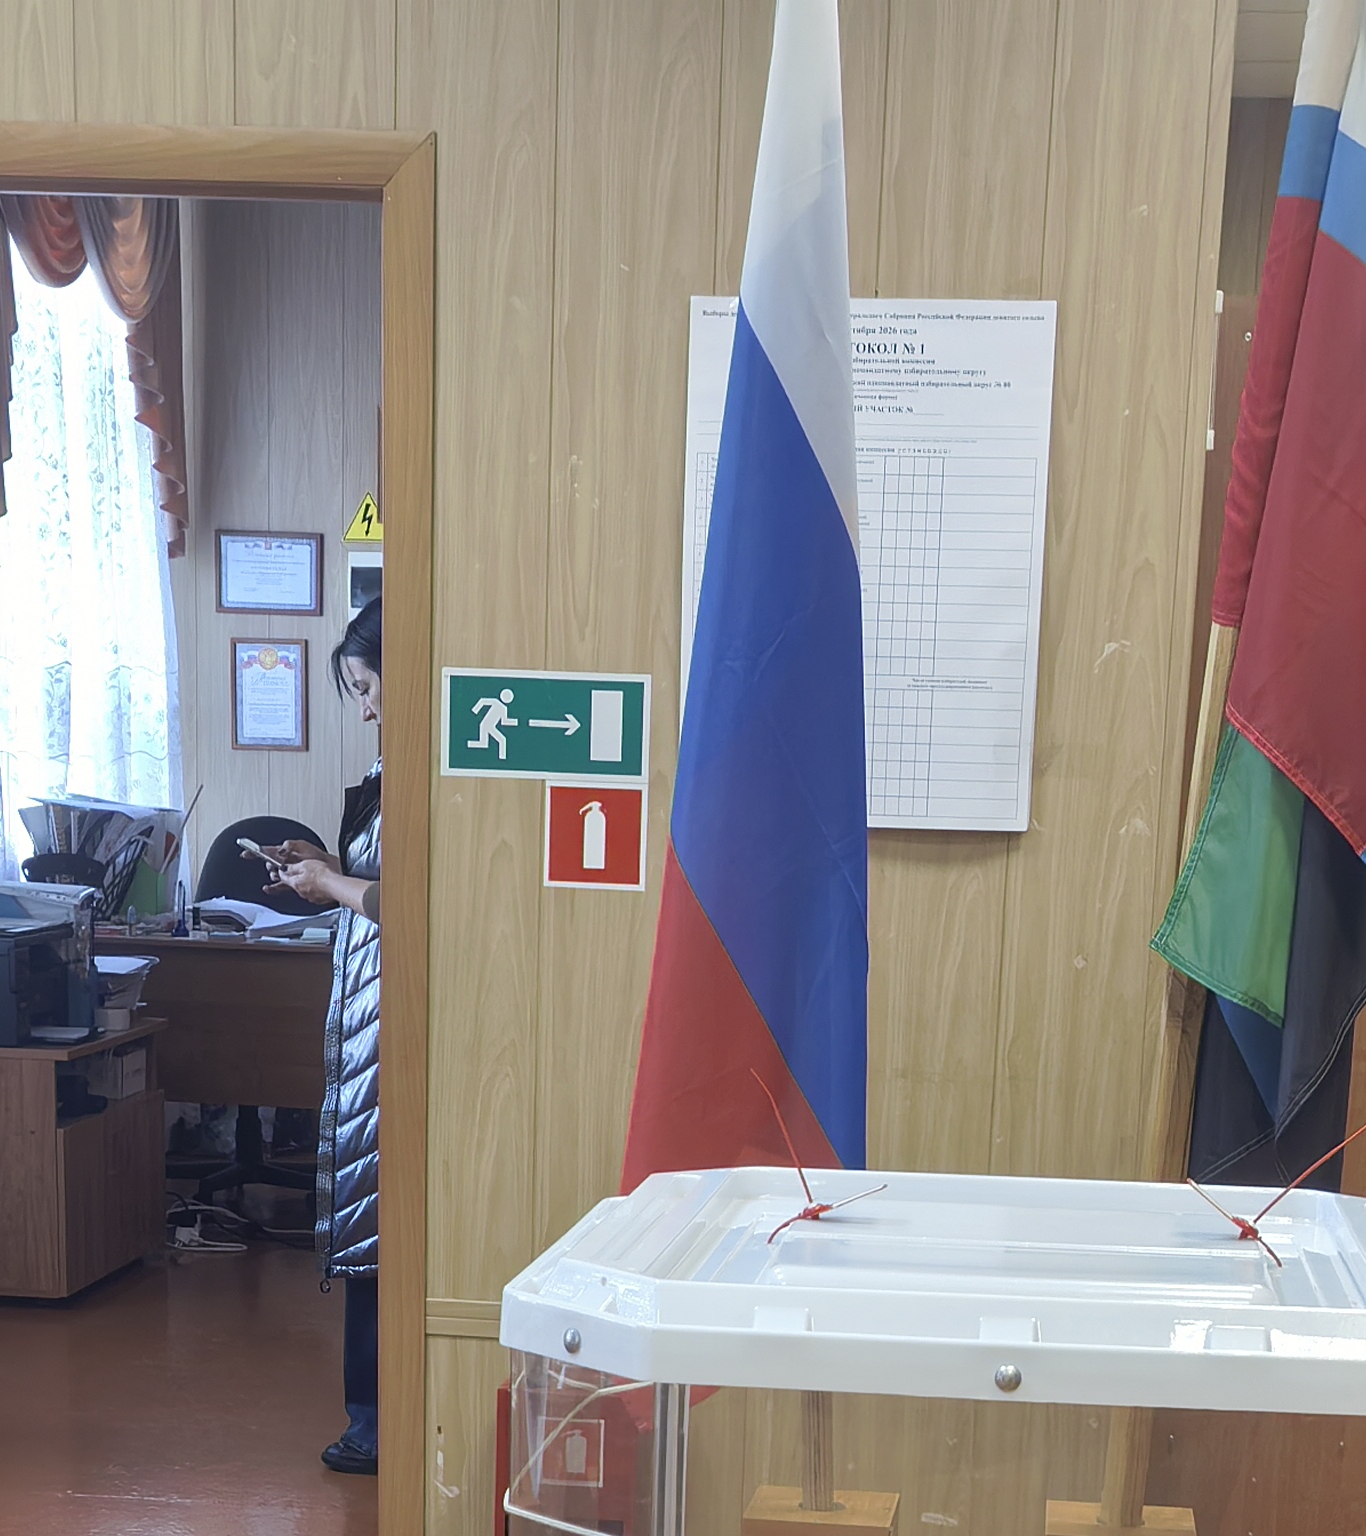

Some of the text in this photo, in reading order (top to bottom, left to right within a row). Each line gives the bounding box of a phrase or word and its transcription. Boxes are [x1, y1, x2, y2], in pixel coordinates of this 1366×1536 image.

[878, 326, 898, 335] 2026
[850, 342, 898, 355] ТОКОЛ
[920, 343, 925, 355] 1
